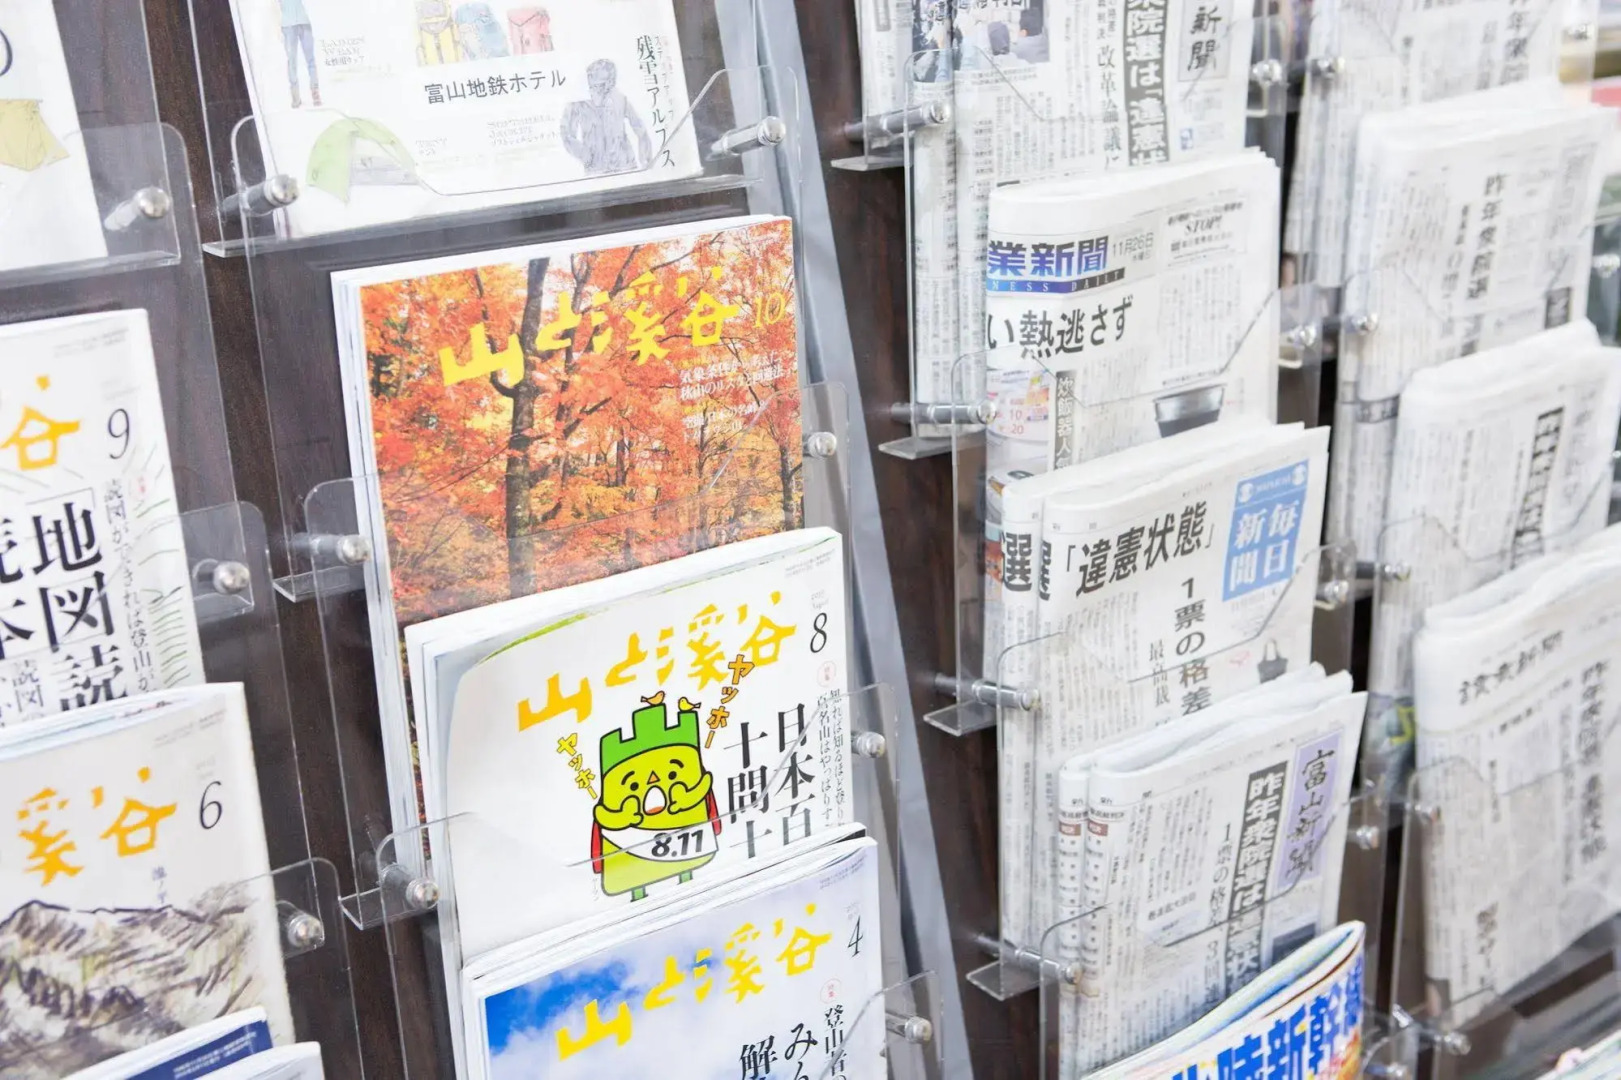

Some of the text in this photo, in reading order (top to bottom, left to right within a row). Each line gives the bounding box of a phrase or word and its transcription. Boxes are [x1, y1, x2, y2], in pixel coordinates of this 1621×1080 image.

[424, 70, 566, 104] 富山地鉄ホテル
[987, 235, 1108, 277] 業新聞
[754, 292, 786, 329] 10
[987, 295, 1133, 359] い熱逃さず
[107, 408, 131, 460] 9
[1065, 500, 1215, 599] 「違憲状態」
[1229, 508, 1268, 592] 新聞
[1263, 499, 1300, 579] 毎日
[32, 502, 129, 713] 地図読
[810, 612, 828, 653] 8
[1174, 577, 1213, 717] 1票の格差
[12, 659, 44, 727] 読図
[702, 654, 755, 749] ヤッホー
[556, 732, 598, 800] ヤッホー
[723, 722, 773, 859] 十問十
[774, 703, 816, 846] 日本百
[199, 781, 223, 830] 6
[650, 829, 704, 857] 8.11
[847, 916, 864, 958] 4
[739, 1035, 778, 1080] 解
[824, 1004, 847, 1080] 登山者
